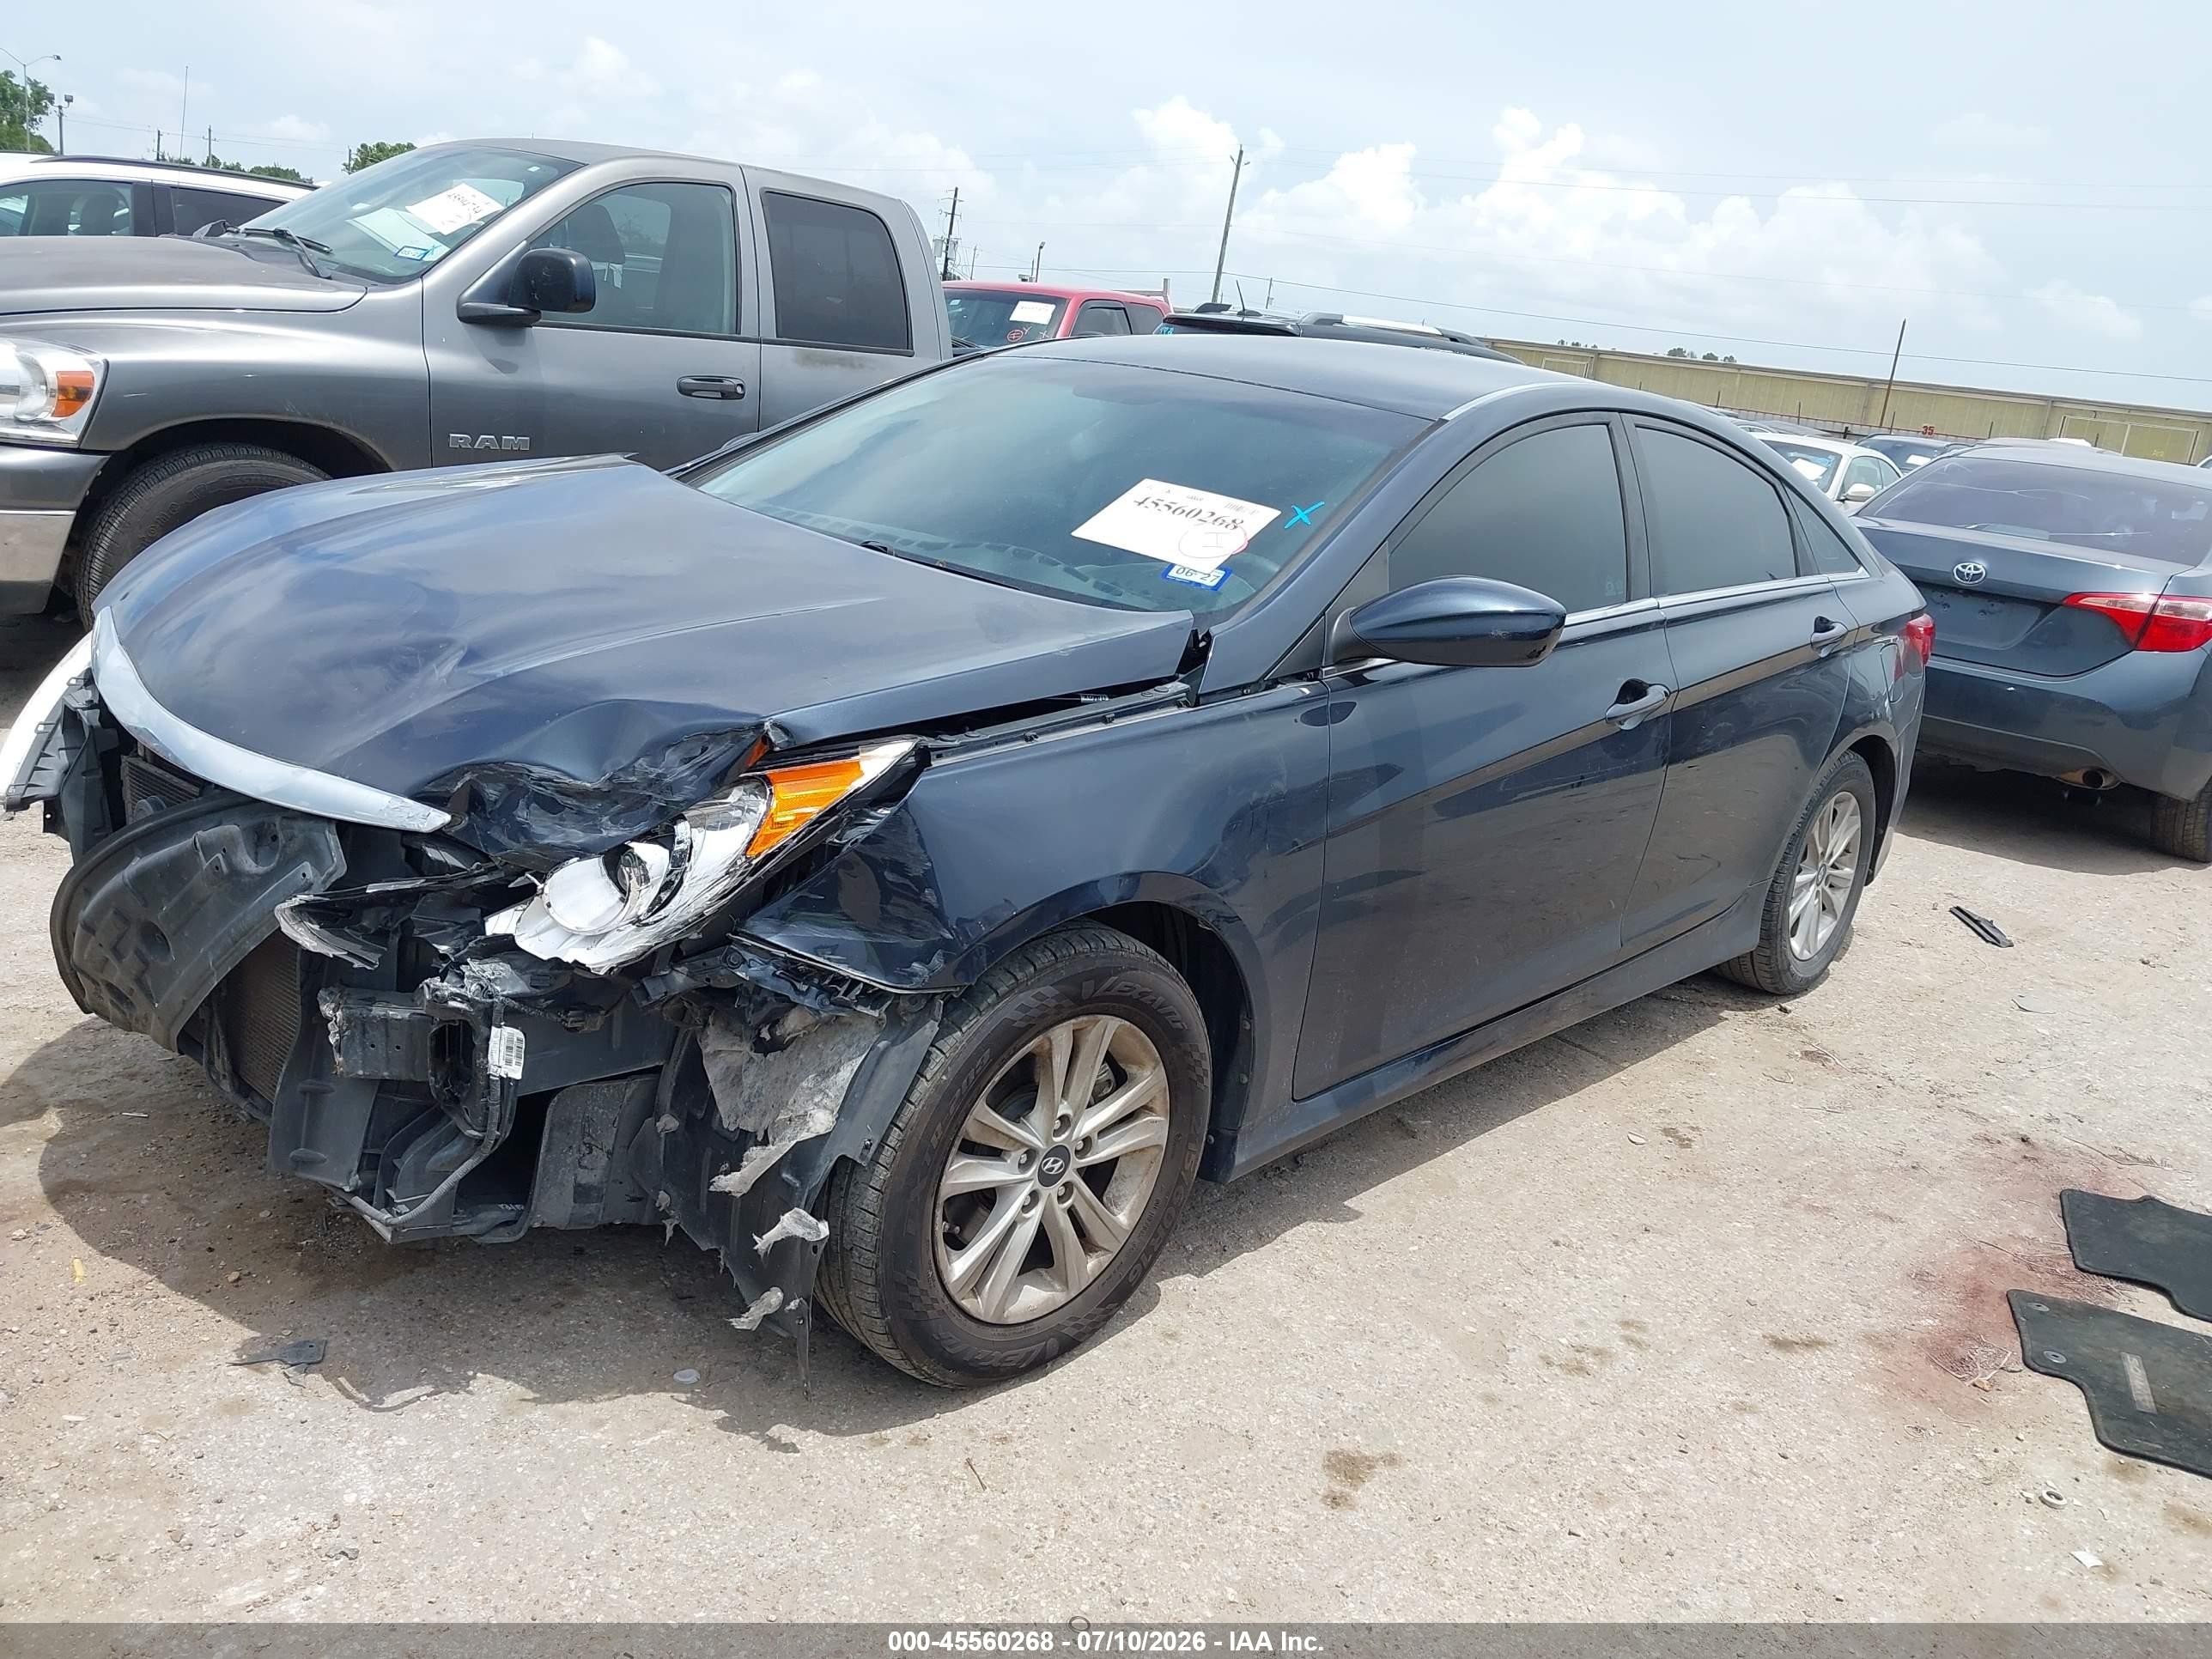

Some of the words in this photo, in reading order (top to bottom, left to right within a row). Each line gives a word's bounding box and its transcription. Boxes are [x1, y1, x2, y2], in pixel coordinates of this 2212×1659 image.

[1923, 425, 1935, 435] 35
[449, 433, 530, 451] RAM
[1133, 495, 1244, 531] 45560268
